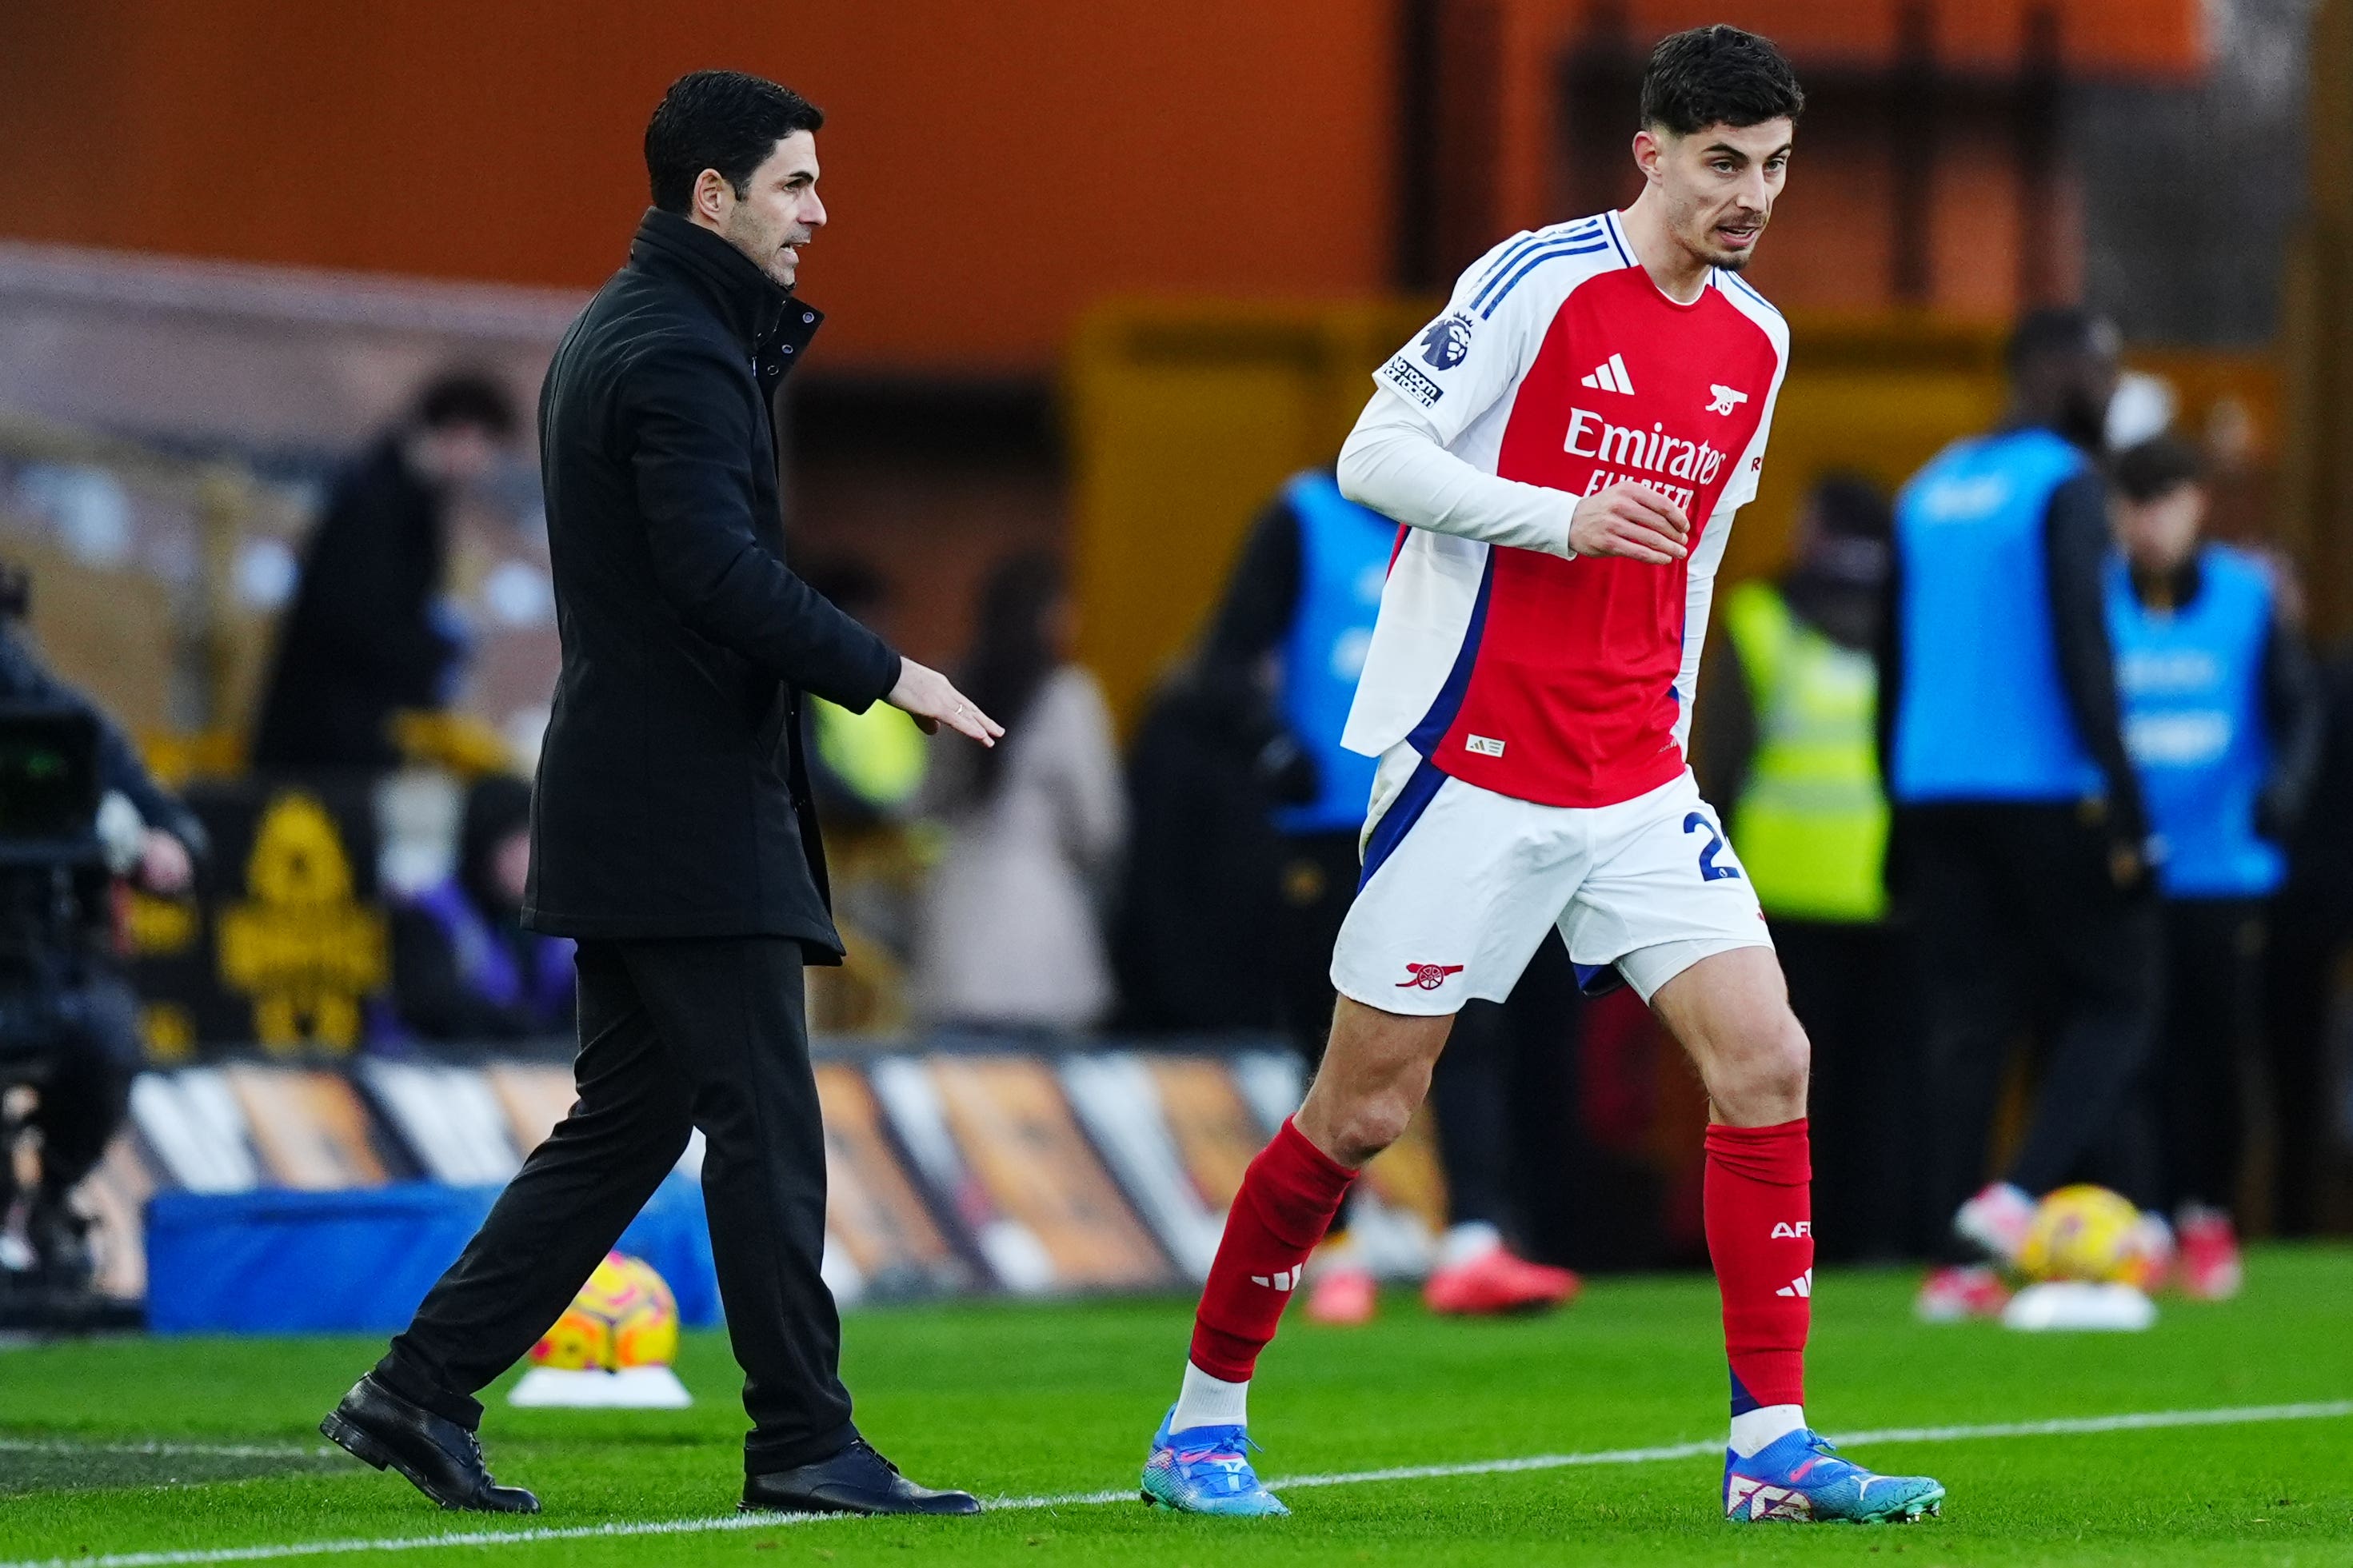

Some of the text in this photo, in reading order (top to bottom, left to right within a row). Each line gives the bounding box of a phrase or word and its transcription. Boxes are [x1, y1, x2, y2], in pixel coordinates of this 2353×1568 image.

[1404, 367, 1438, 398] room
[1563, 406, 1727, 485] Emirates
[1683, 812, 1741, 882] 2
